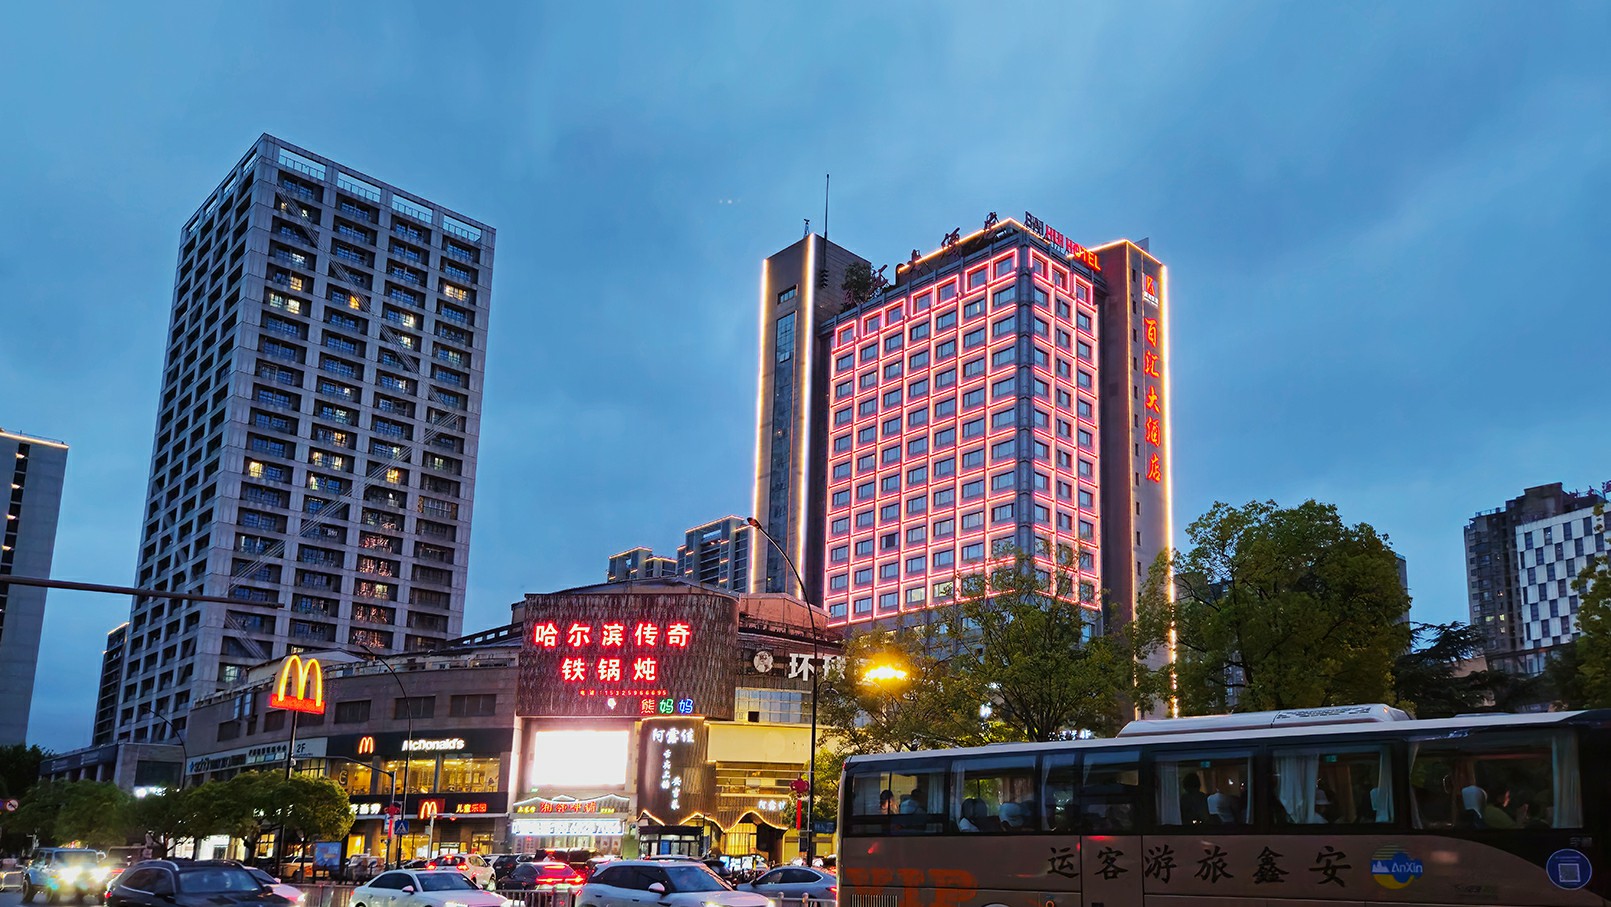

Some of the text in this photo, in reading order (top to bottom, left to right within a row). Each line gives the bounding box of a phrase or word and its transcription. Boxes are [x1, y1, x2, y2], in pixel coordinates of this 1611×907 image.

[1045, 225, 1064, 248] HUI
[1065, 237, 1102, 271] HOTEL
[1144, 317, 1161, 483] 百汇大酒店
[535, 623, 690, 647] 哈尔滨传奇
[562, 658, 656, 681] 铁锅炖
[640, 699, 694, 714] 熊妈妈
[402, 738, 465, 751] McDonald's
[455, 803, 488, 813] 儿童乐园
[1391, 861, 1424, 873] AnXin
